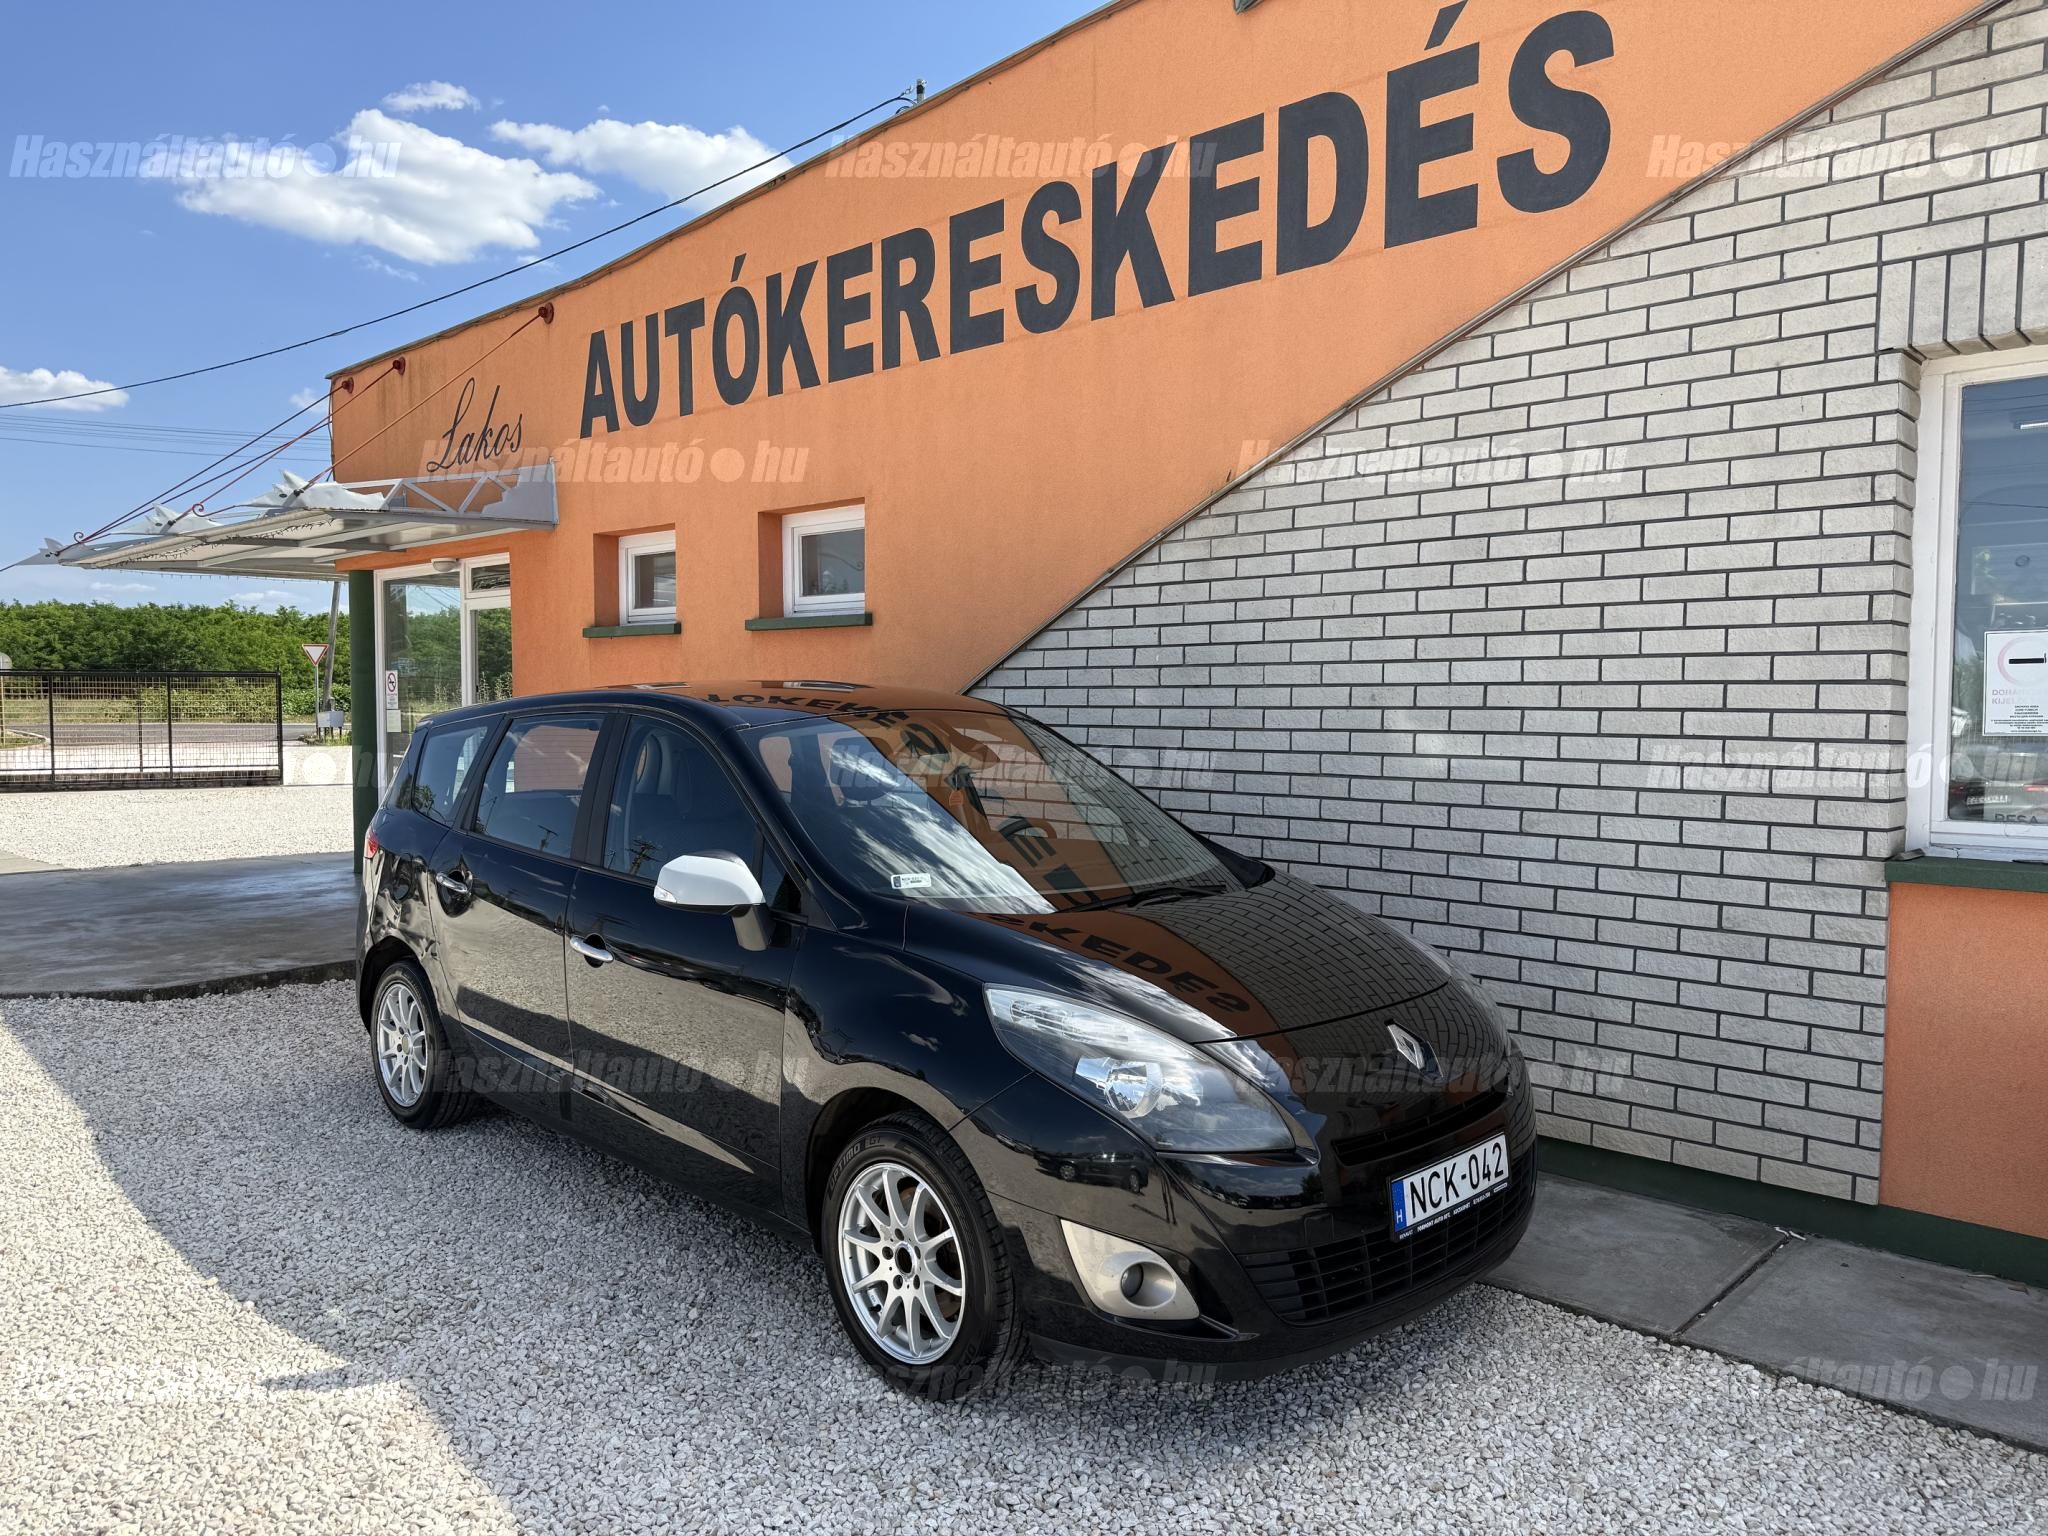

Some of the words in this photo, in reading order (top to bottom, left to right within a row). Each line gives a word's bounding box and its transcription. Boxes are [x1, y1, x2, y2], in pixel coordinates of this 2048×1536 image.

[580, 0, 1614, 438] AUTÓKERESKEDÉS
[426, 376, 523, 473] Lakos
[1395, 1209, 1404, 1225] H
[1409, 1141, 1505, 1219] NCK-042
